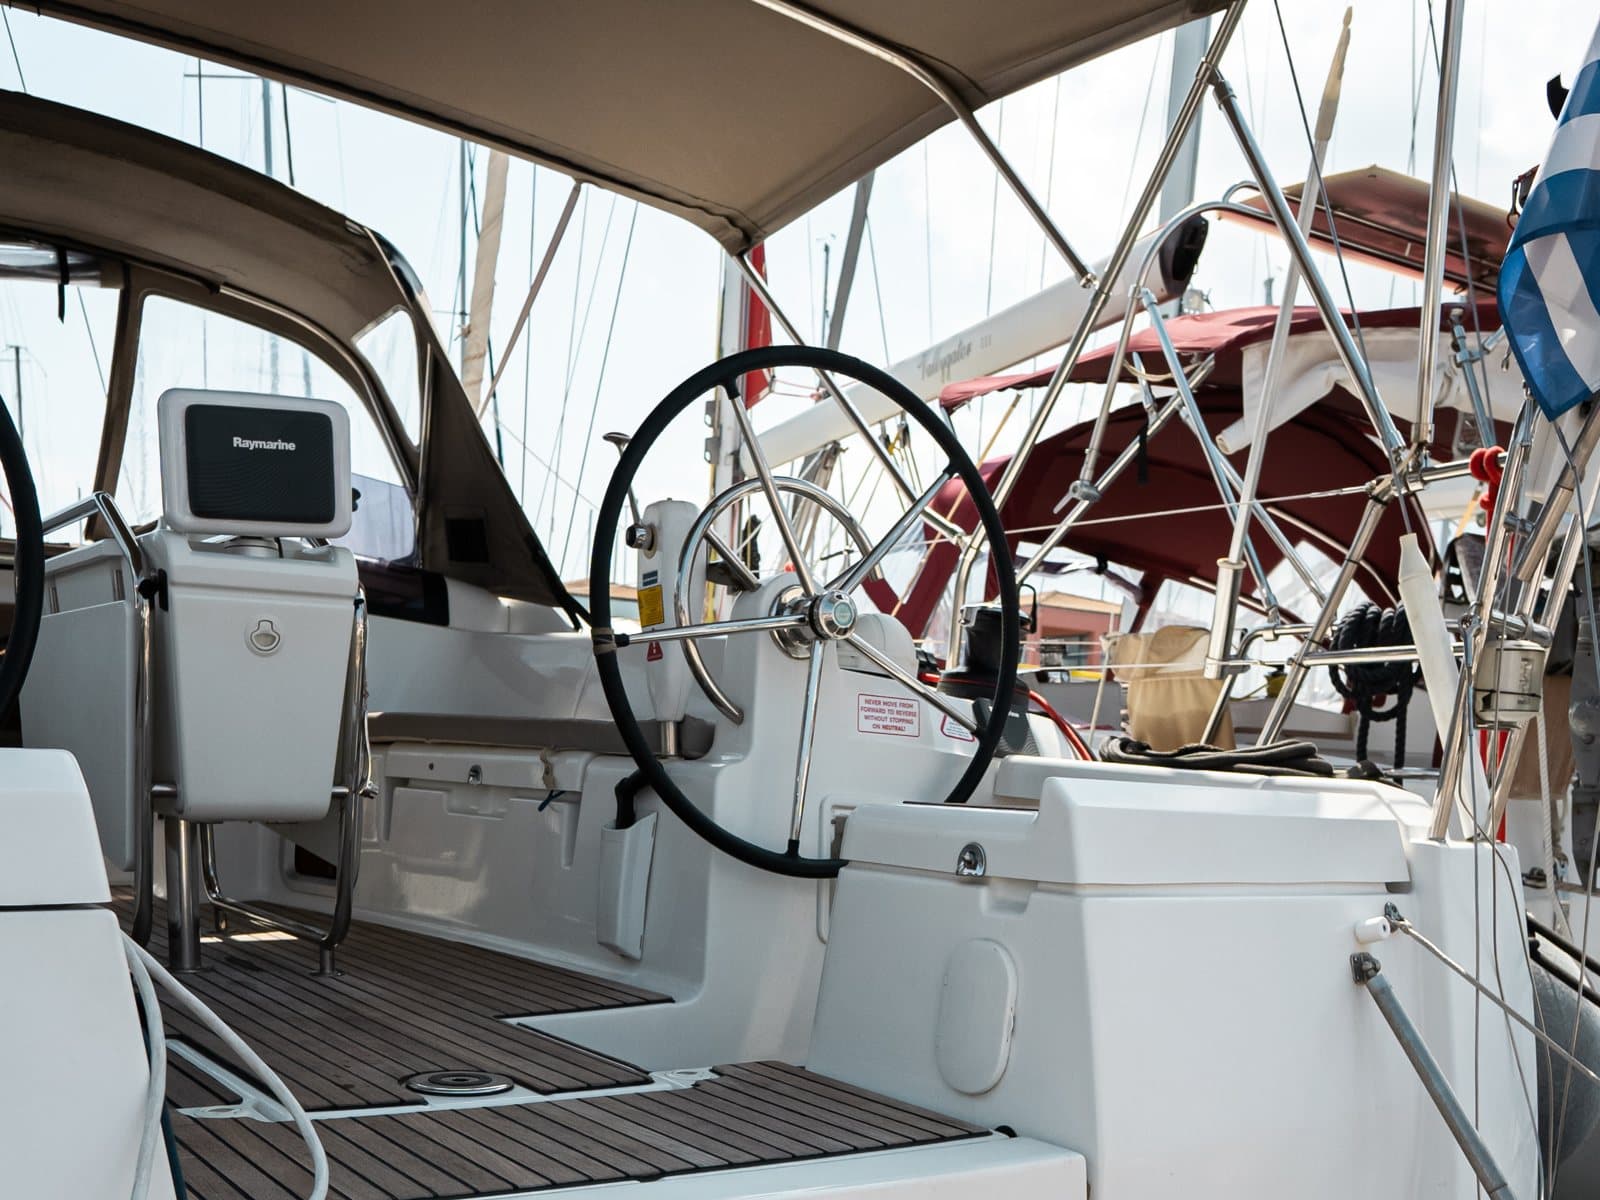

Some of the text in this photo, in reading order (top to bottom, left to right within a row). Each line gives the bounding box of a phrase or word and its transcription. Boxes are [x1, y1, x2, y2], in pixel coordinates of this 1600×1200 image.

[233, 436, 296, 451] Raymarine
[860, 706, 886, 714] FORWARD
[896, 709, 917, 717] REVERSE
[864, 714, 888, 722] WITHOUT
